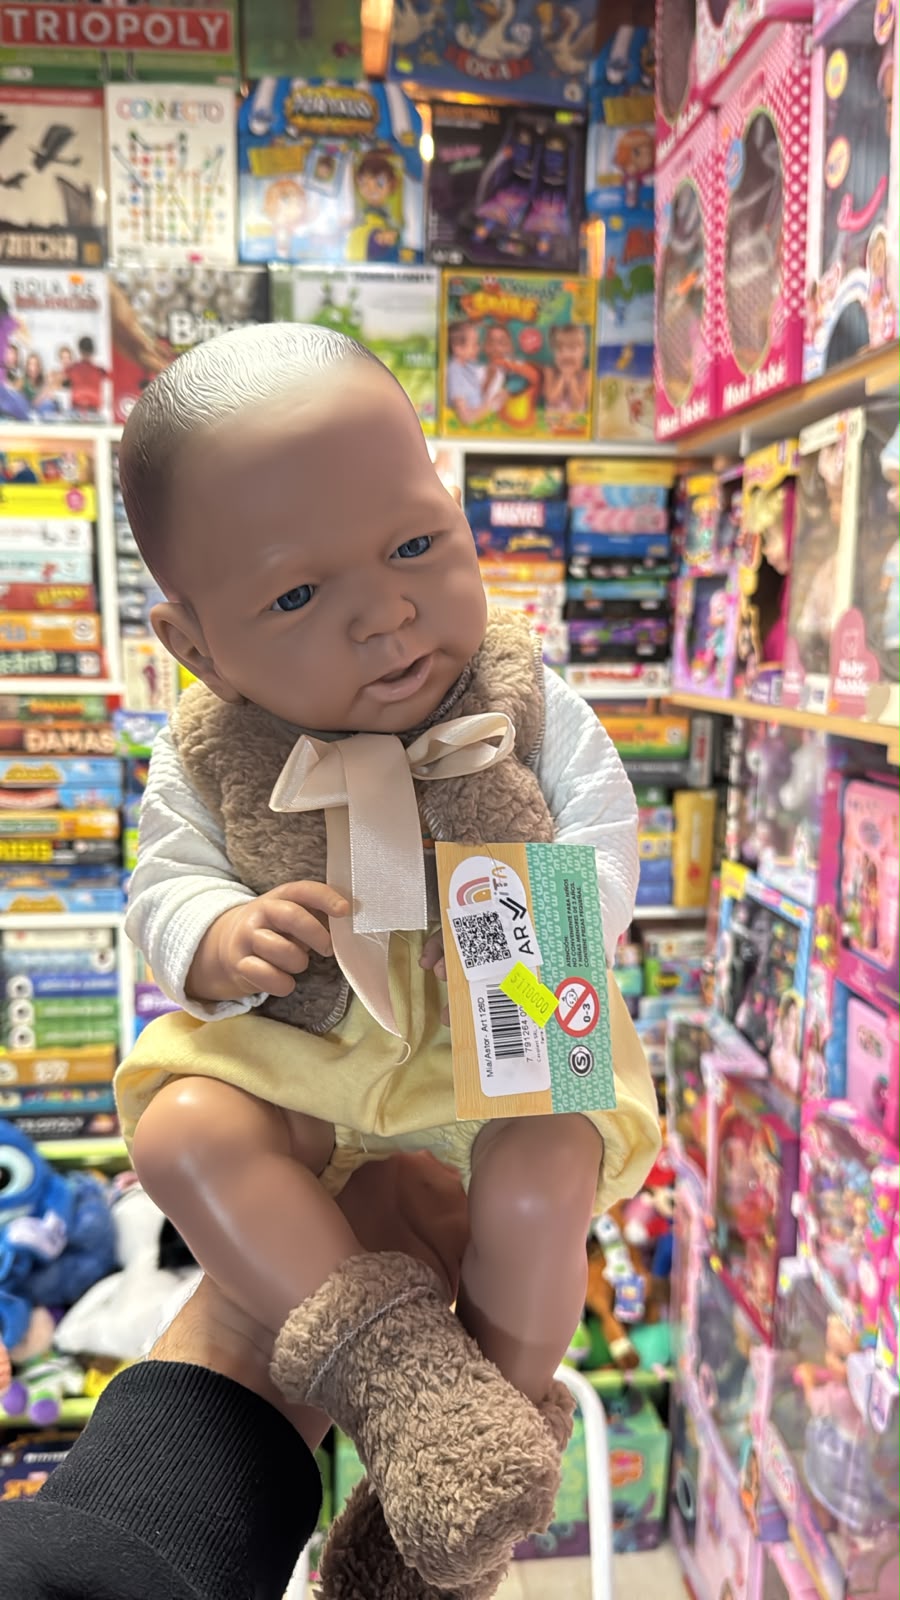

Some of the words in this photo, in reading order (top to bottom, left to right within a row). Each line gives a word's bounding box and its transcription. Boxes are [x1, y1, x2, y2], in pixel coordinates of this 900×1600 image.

[3, 8, 225, 48] TRIOPOLY
[24, 729, 116, 752] DAMAS
[513, 925, 534, 955] AR
[567, 915, 577, 957] CONVENIENTE
[480, 1019, 488, 1032] Art
[582, 1003, 591, 1023] 0-3
[521, 1020, 532, 1053] 791264
